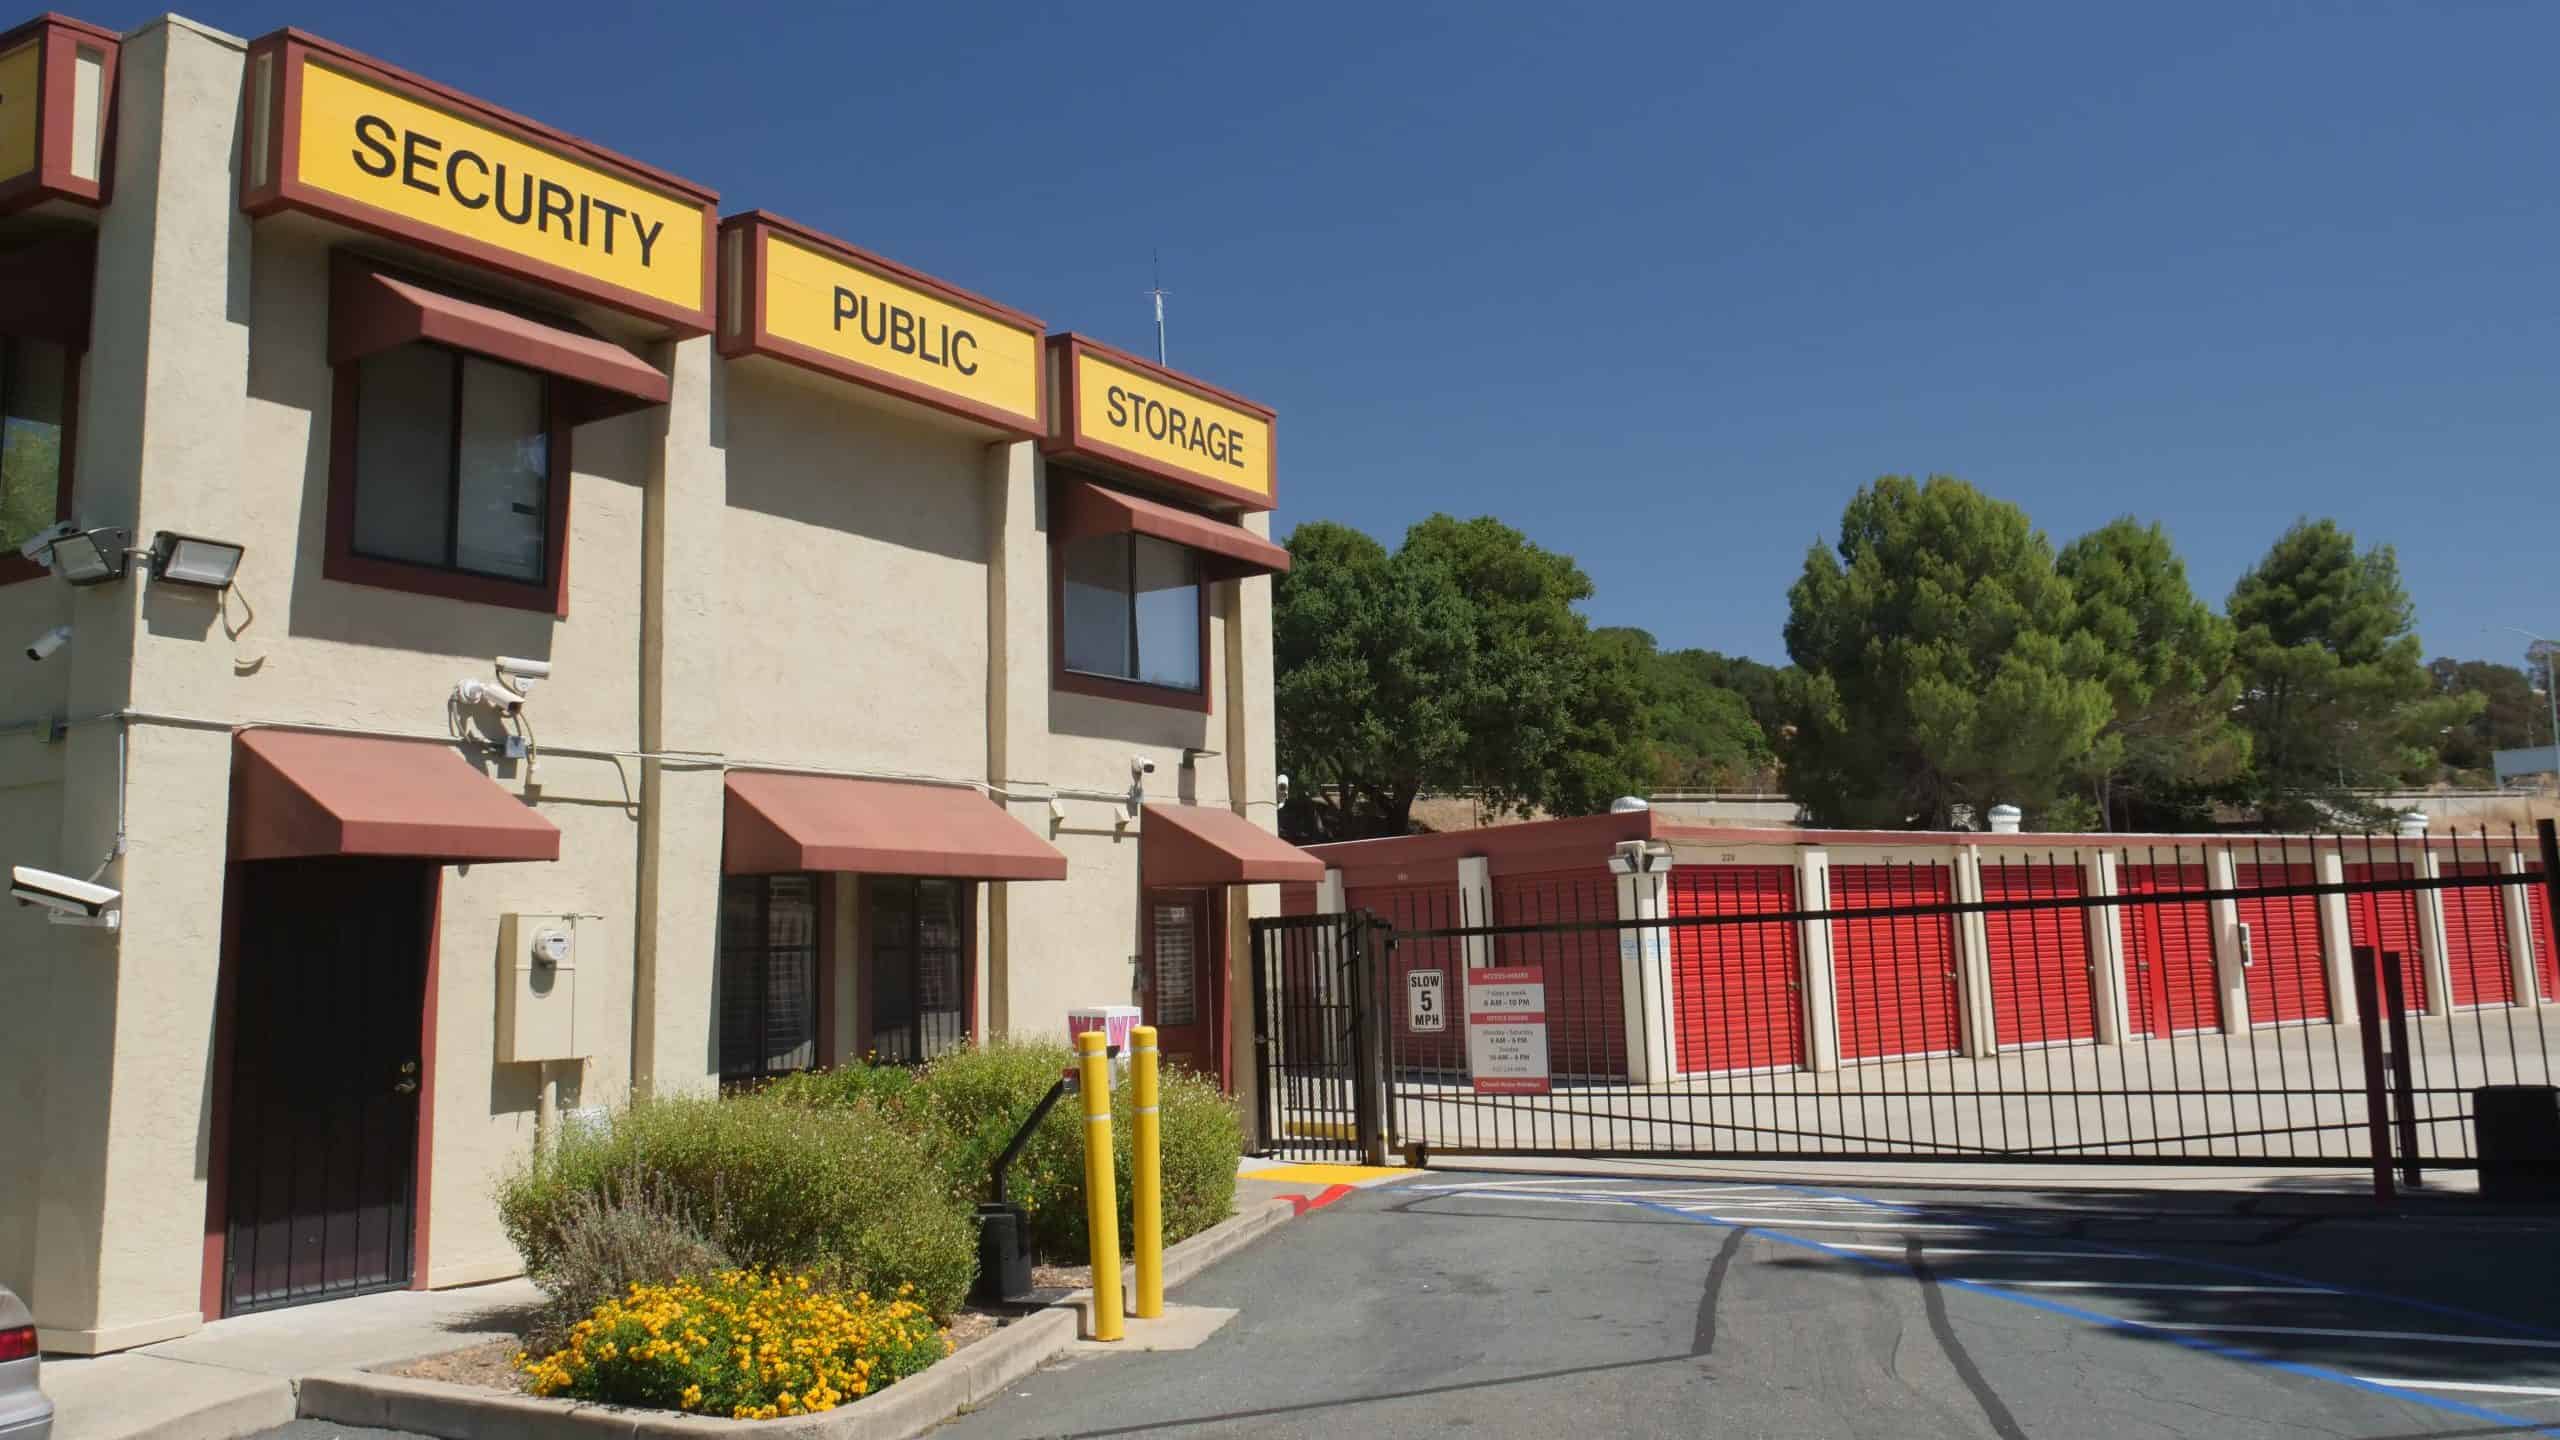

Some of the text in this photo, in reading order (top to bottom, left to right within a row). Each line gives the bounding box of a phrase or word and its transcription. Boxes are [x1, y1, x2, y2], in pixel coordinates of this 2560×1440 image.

[351, 115, 664, 267] SECURITY
[834, 286, 978, 376] PUBLIC
[1107, 386, 1244, 468] STORAGE
[1411, 975, 1440, 987] SLOW
[1421, 990, 1432, 1011] 5
[1415, 1014, 1439, 1025] MPH
